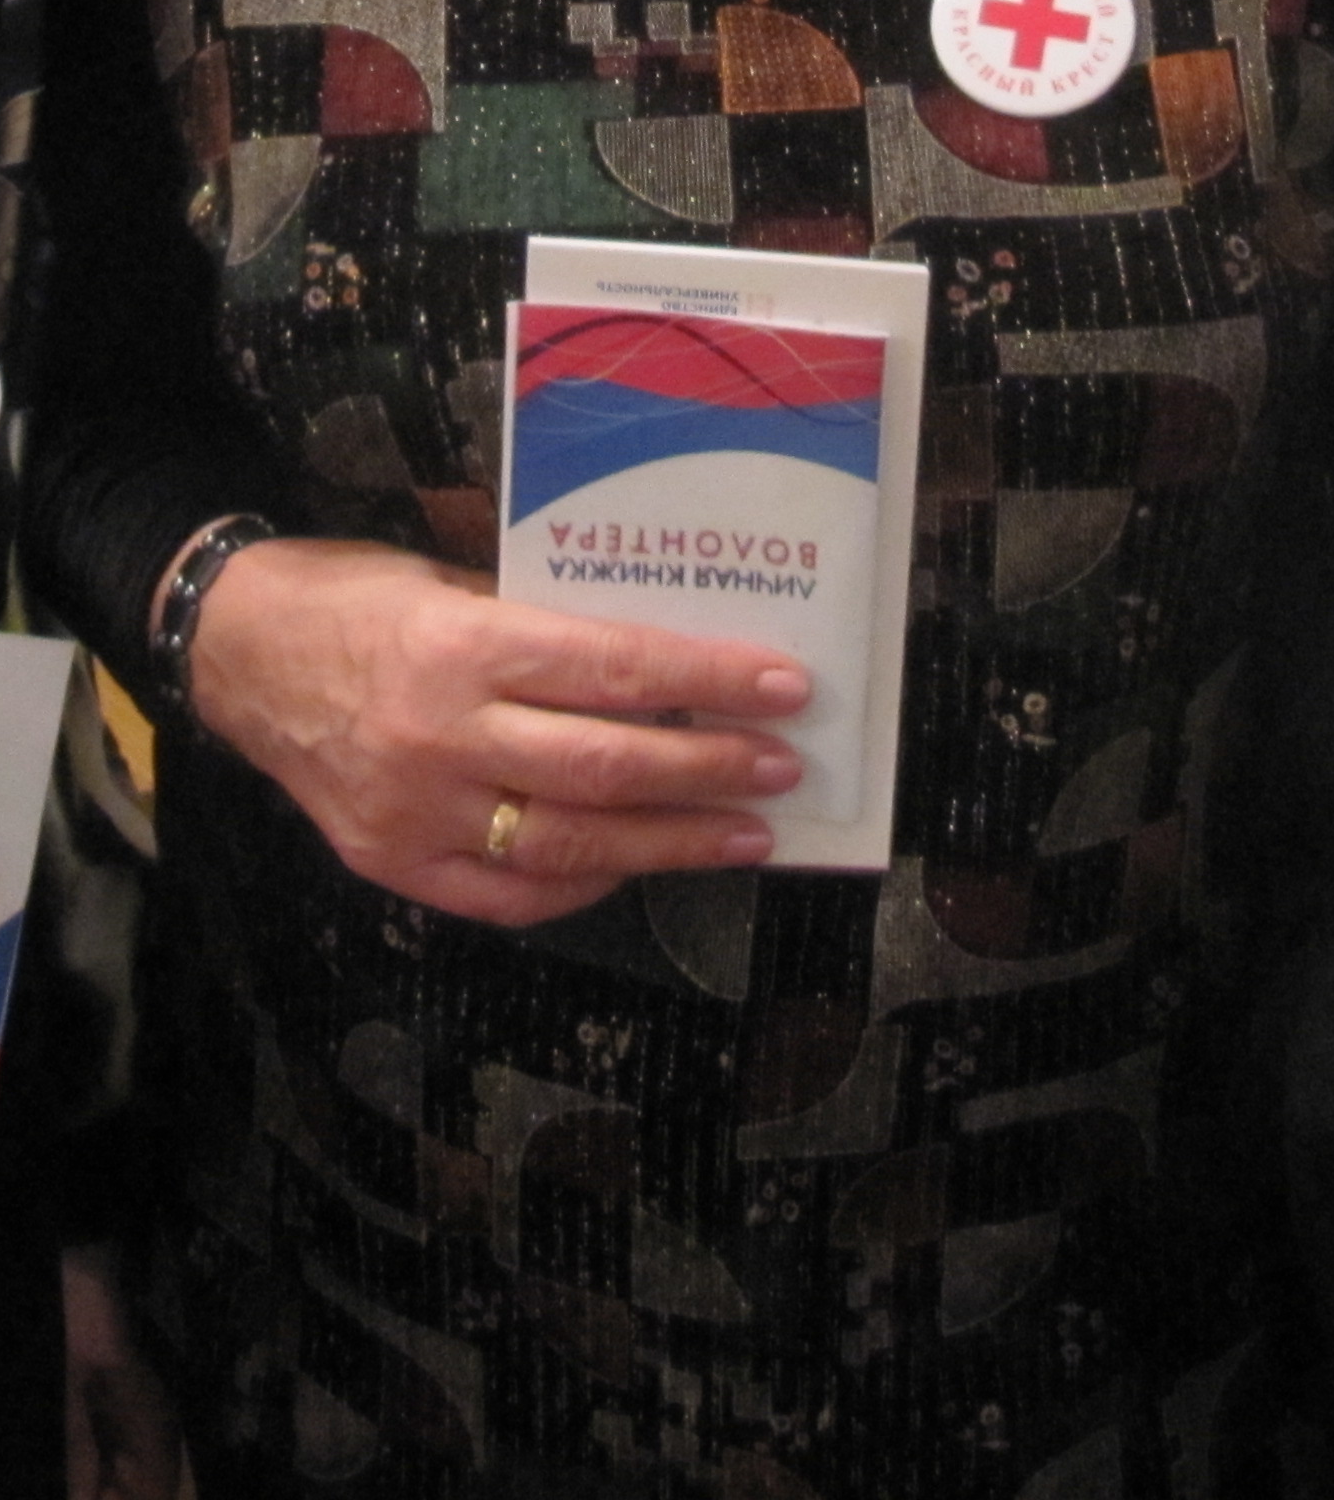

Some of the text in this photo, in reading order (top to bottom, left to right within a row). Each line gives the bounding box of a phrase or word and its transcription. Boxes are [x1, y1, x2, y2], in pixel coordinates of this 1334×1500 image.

[952, 8, 1115, 97] КРАСНЫЙ КРЕСТ
[596, 281, 738, 301] УНИВЕРСАЛЬНОСТЬ
[660, 300, 738, 316] ЕДИНСТВО
[546, 555, 817, 601] ЛИЧНАЯ КНИЖКА
